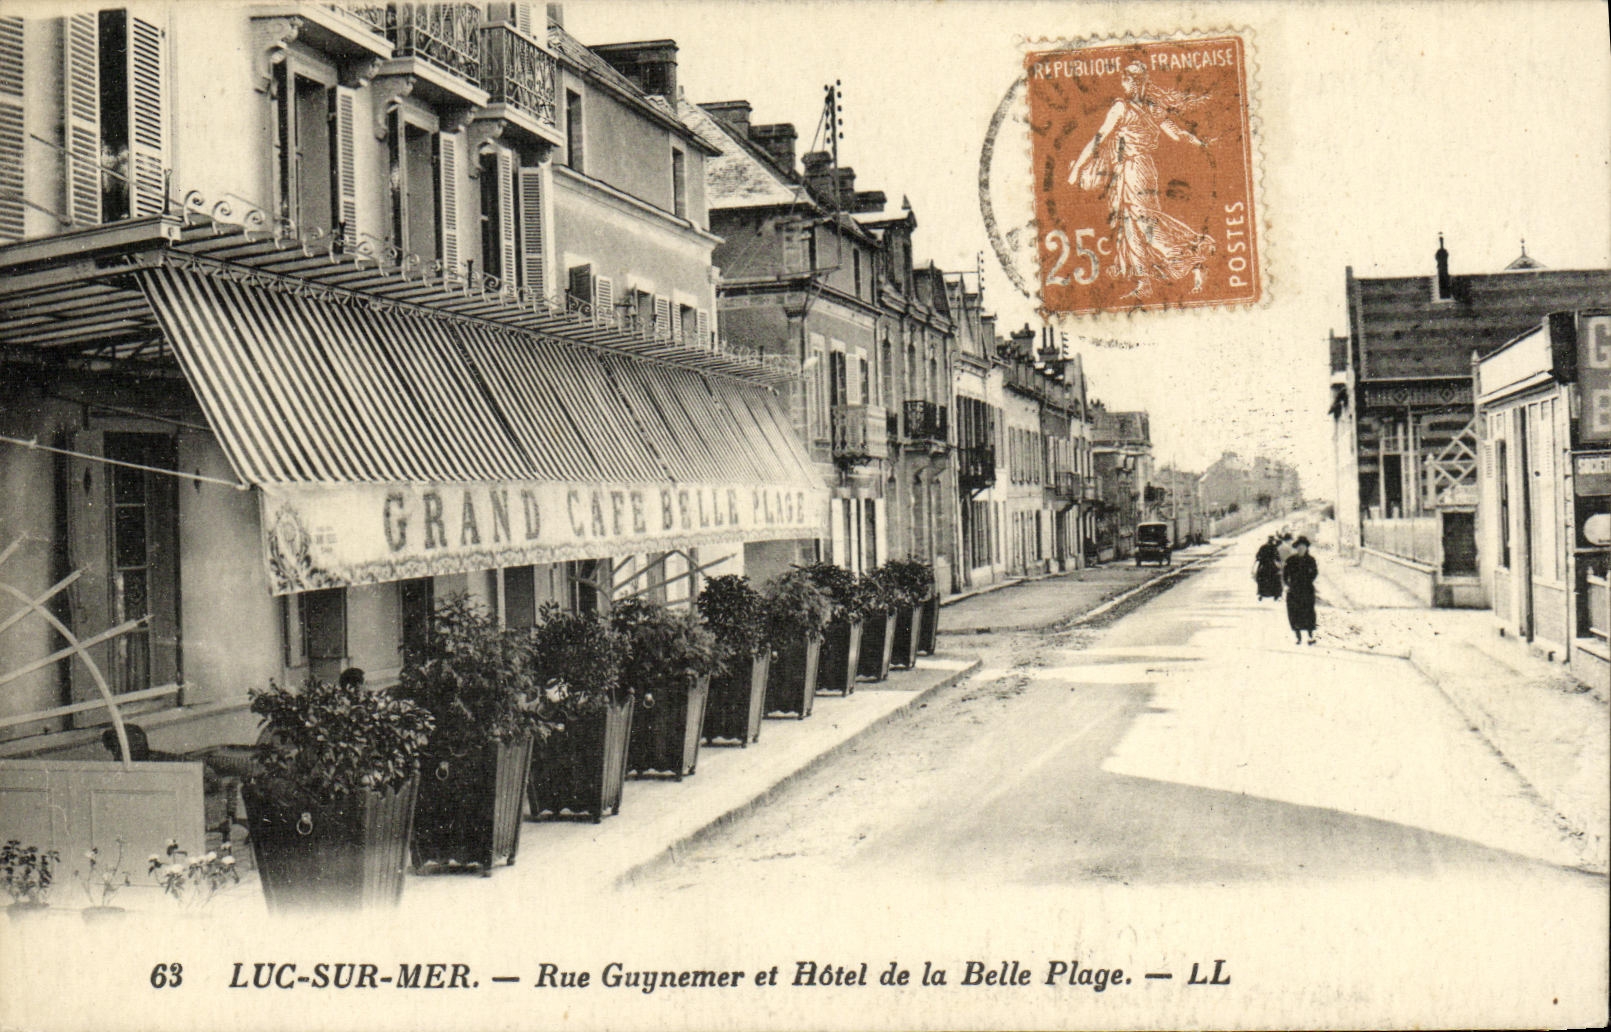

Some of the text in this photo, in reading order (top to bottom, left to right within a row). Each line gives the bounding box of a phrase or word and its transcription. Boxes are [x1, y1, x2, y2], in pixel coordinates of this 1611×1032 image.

[1224, 201, 1248, 288] POSTES
[383, 488, 541, 552] GRAND
[566, 489, 647, 537] CAFE
[660, 488, 739, 531] BELLE
[752, 489, 804, 525] PLAGE
